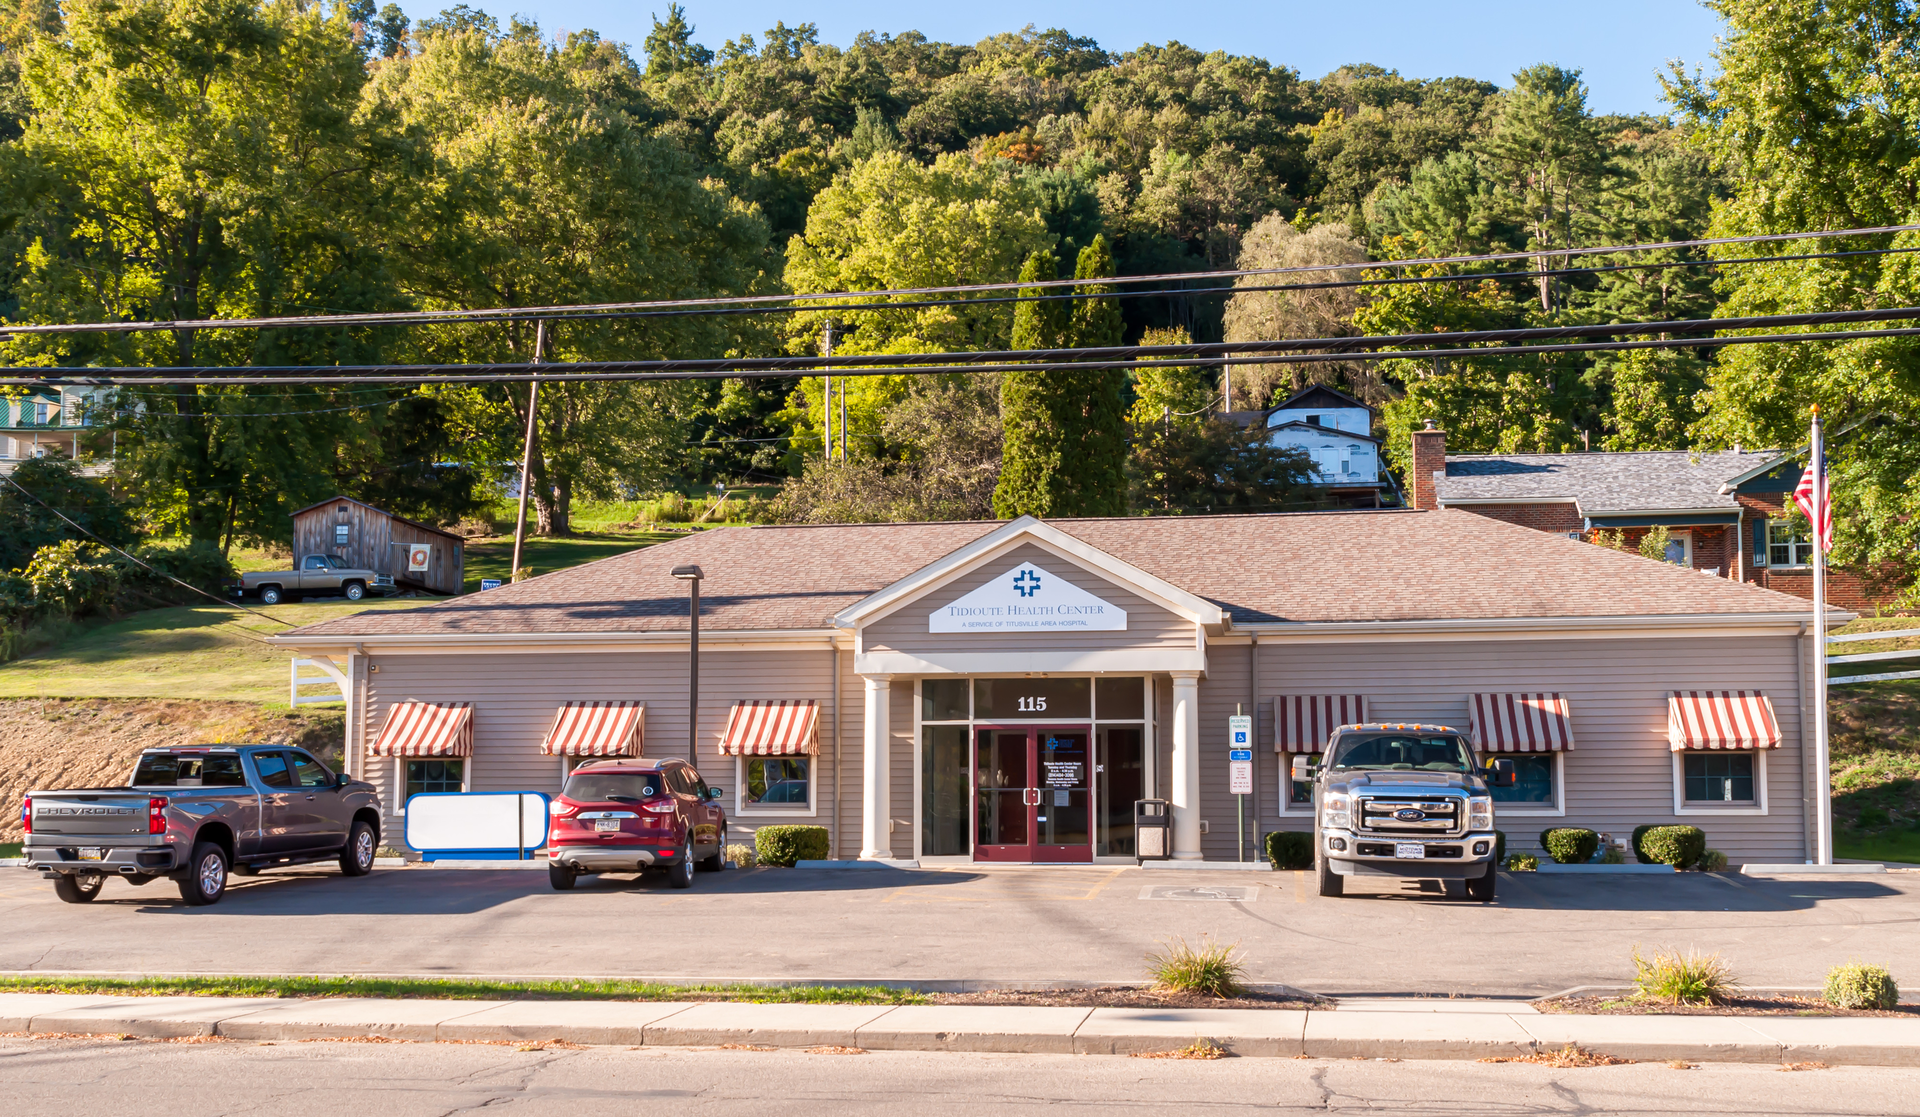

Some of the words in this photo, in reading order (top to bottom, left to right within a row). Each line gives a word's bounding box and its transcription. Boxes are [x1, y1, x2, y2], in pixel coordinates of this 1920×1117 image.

[948, 606, 1004, 617] TIDIOUTE
[1007, 605, 1054, 616] HEALTH
[1057, 604, 1104, 615] CENTER
[1017, 696, 1047, 712] 115
[37, 807, 141, 816] CHEVROLET
